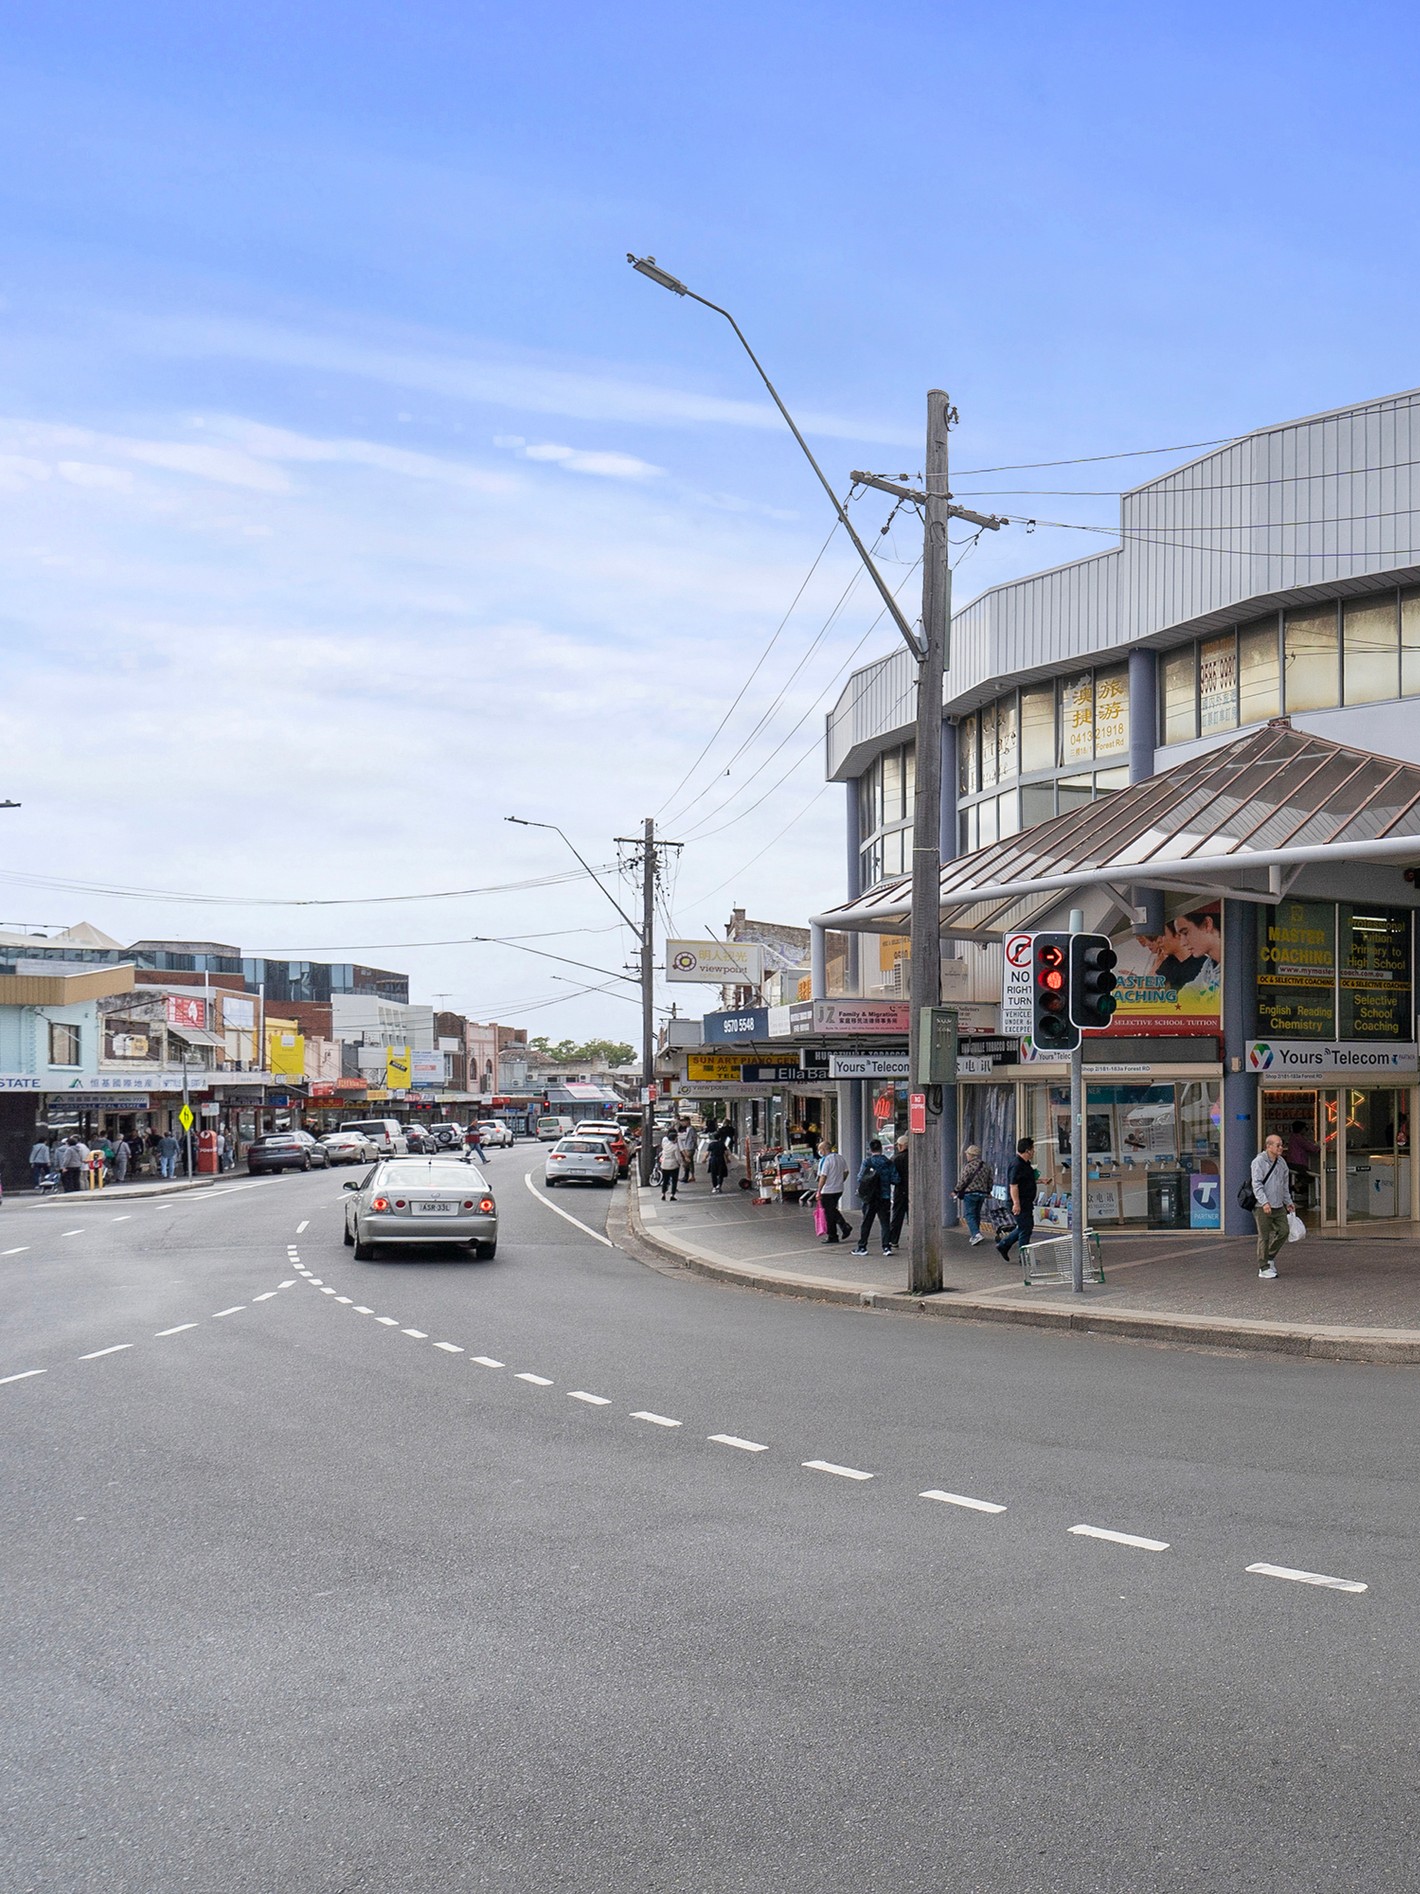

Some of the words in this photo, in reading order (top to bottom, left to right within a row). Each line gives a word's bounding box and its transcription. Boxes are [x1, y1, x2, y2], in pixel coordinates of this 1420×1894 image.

[1116, 738, 1124, 746] Rd
[1268, 926, 1325, 945] MASTER
[1361, 932, 1393, 943] Tuition
[1261, 946, 1333, 965] COACHING
[1351, 944, 1388, 957] Primary
[1392, 947, 1401, 957] to
[1347, 957, 1369, 970] High
[1373, 959, 1406, 970] School
[699, 965, 748, 975] viewpoint
[1011, 971, 1030, 983] NO
[1275, 977, 1304, 985] SELECTIVE
[1304, 978, 1335, 986] COACHING
[1355, 981, 1383, 989] SELECTIVE
[1008, 997, 1032, 1005] TURN
[1354, 994, 1398, 1006] Selective
[839, 1011, 859, 1019] Family
[1259, 1004, 1292, 1016] English
[1297, 1006, 1333, 1018] Reading
[1360, 1008, 1393, 1019] School
[724, 1019, 738, 1033] 9570
[1270, 1018, 1323, 1032] Chemistry
[1354, 1020, 1399, 1033] Coaching
[692, 1056, 715, 1064] SUN
[717, 1056, 738, 1064] ART
[741, 1056, 773, 1064] PIANO
[1280, 1049, 1323, 1064] Yours
[1331, 1050, 1390, 1065] Telecom
[836, 1060, 866, 1073] Yours
[779, 1068, 806, 1080] Ella
